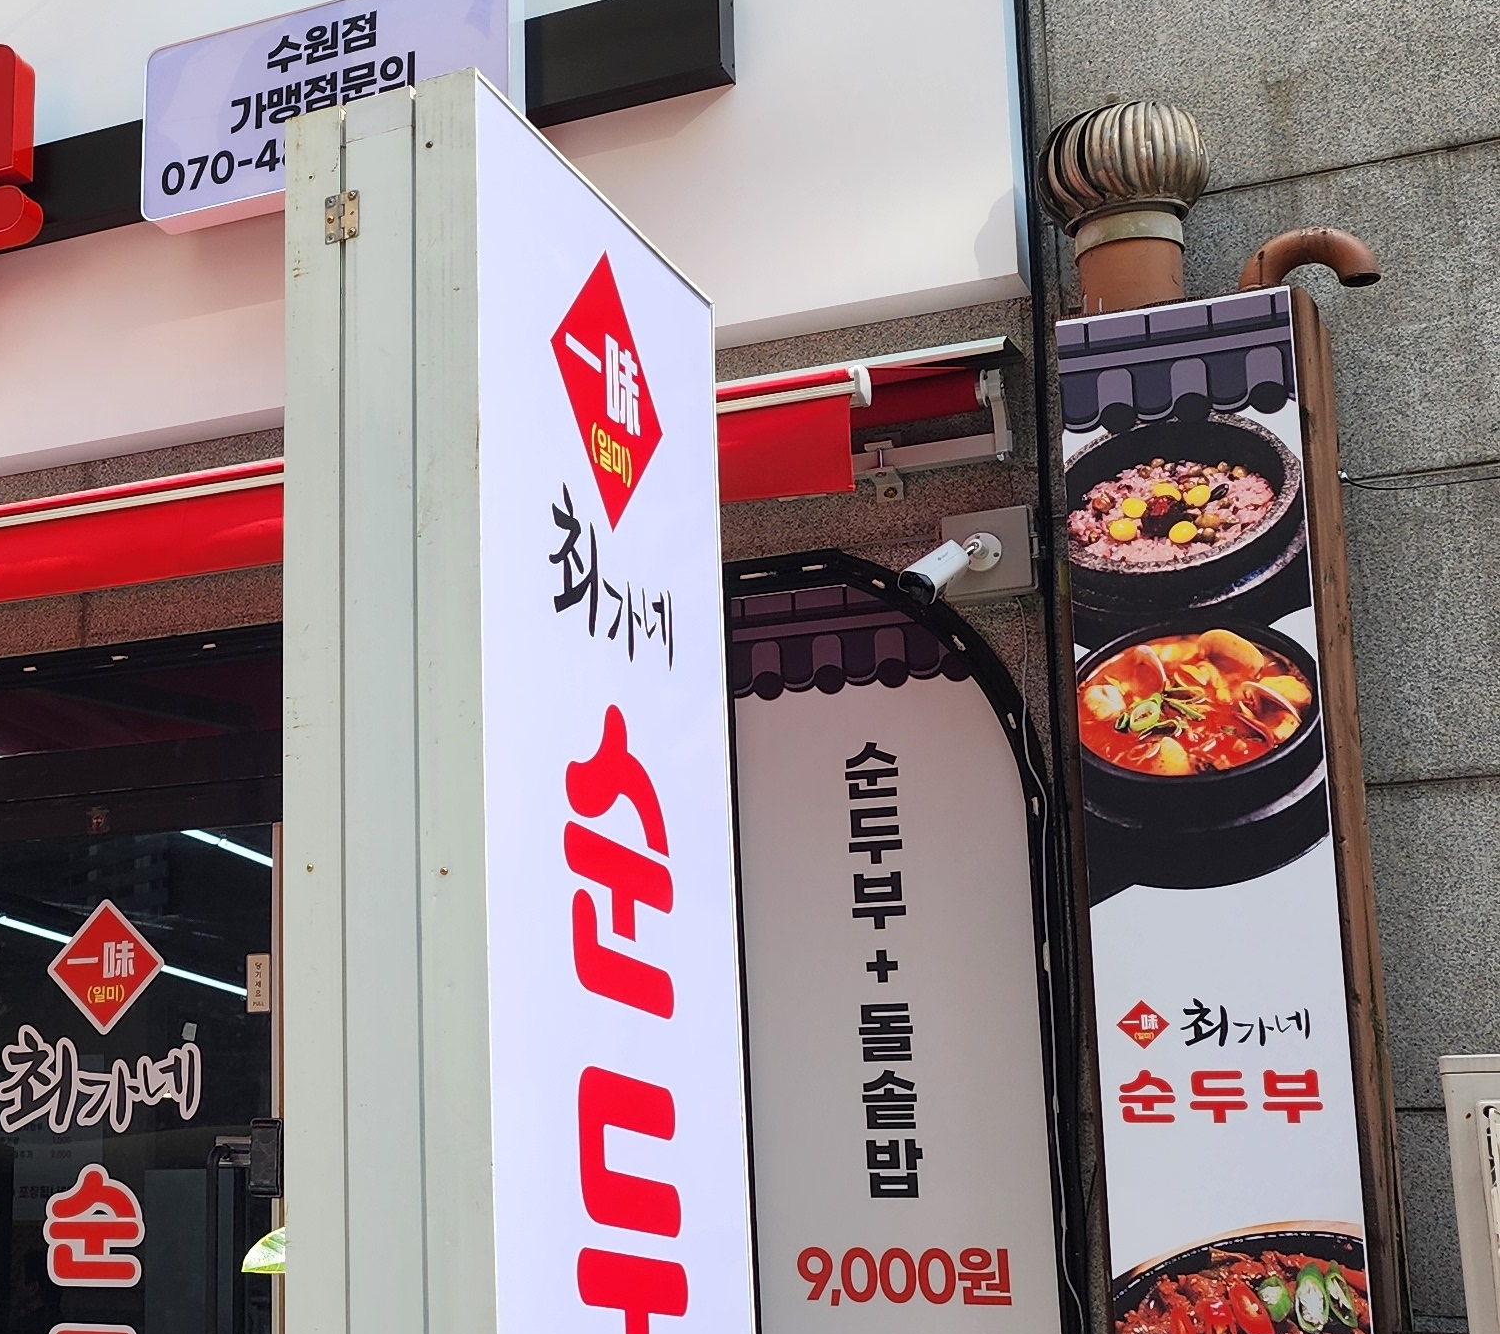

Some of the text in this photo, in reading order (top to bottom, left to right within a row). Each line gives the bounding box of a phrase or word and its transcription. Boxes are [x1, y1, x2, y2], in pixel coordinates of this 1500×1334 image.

[267, 10, 377, 73] 수원점
[230, 51, 415, 134] 가맹점문의
[161, 138, 285, 195] 070-4
[565, 331, 640, 436] 一味
[591, 421, 632, 488] (일미)
[549, 482, 673, 671] 최가네
[67, 940, 134, 979] 一味
[87, 985, 125, 1003] (일미)
[1122, 1014, 1158, 1030] 一味
[1180, 998, 1310, 1047] 최가네
[1119, 1069, 1323, 1123] 순두부
[797, 1247, 1011, 1306] 9,000원
